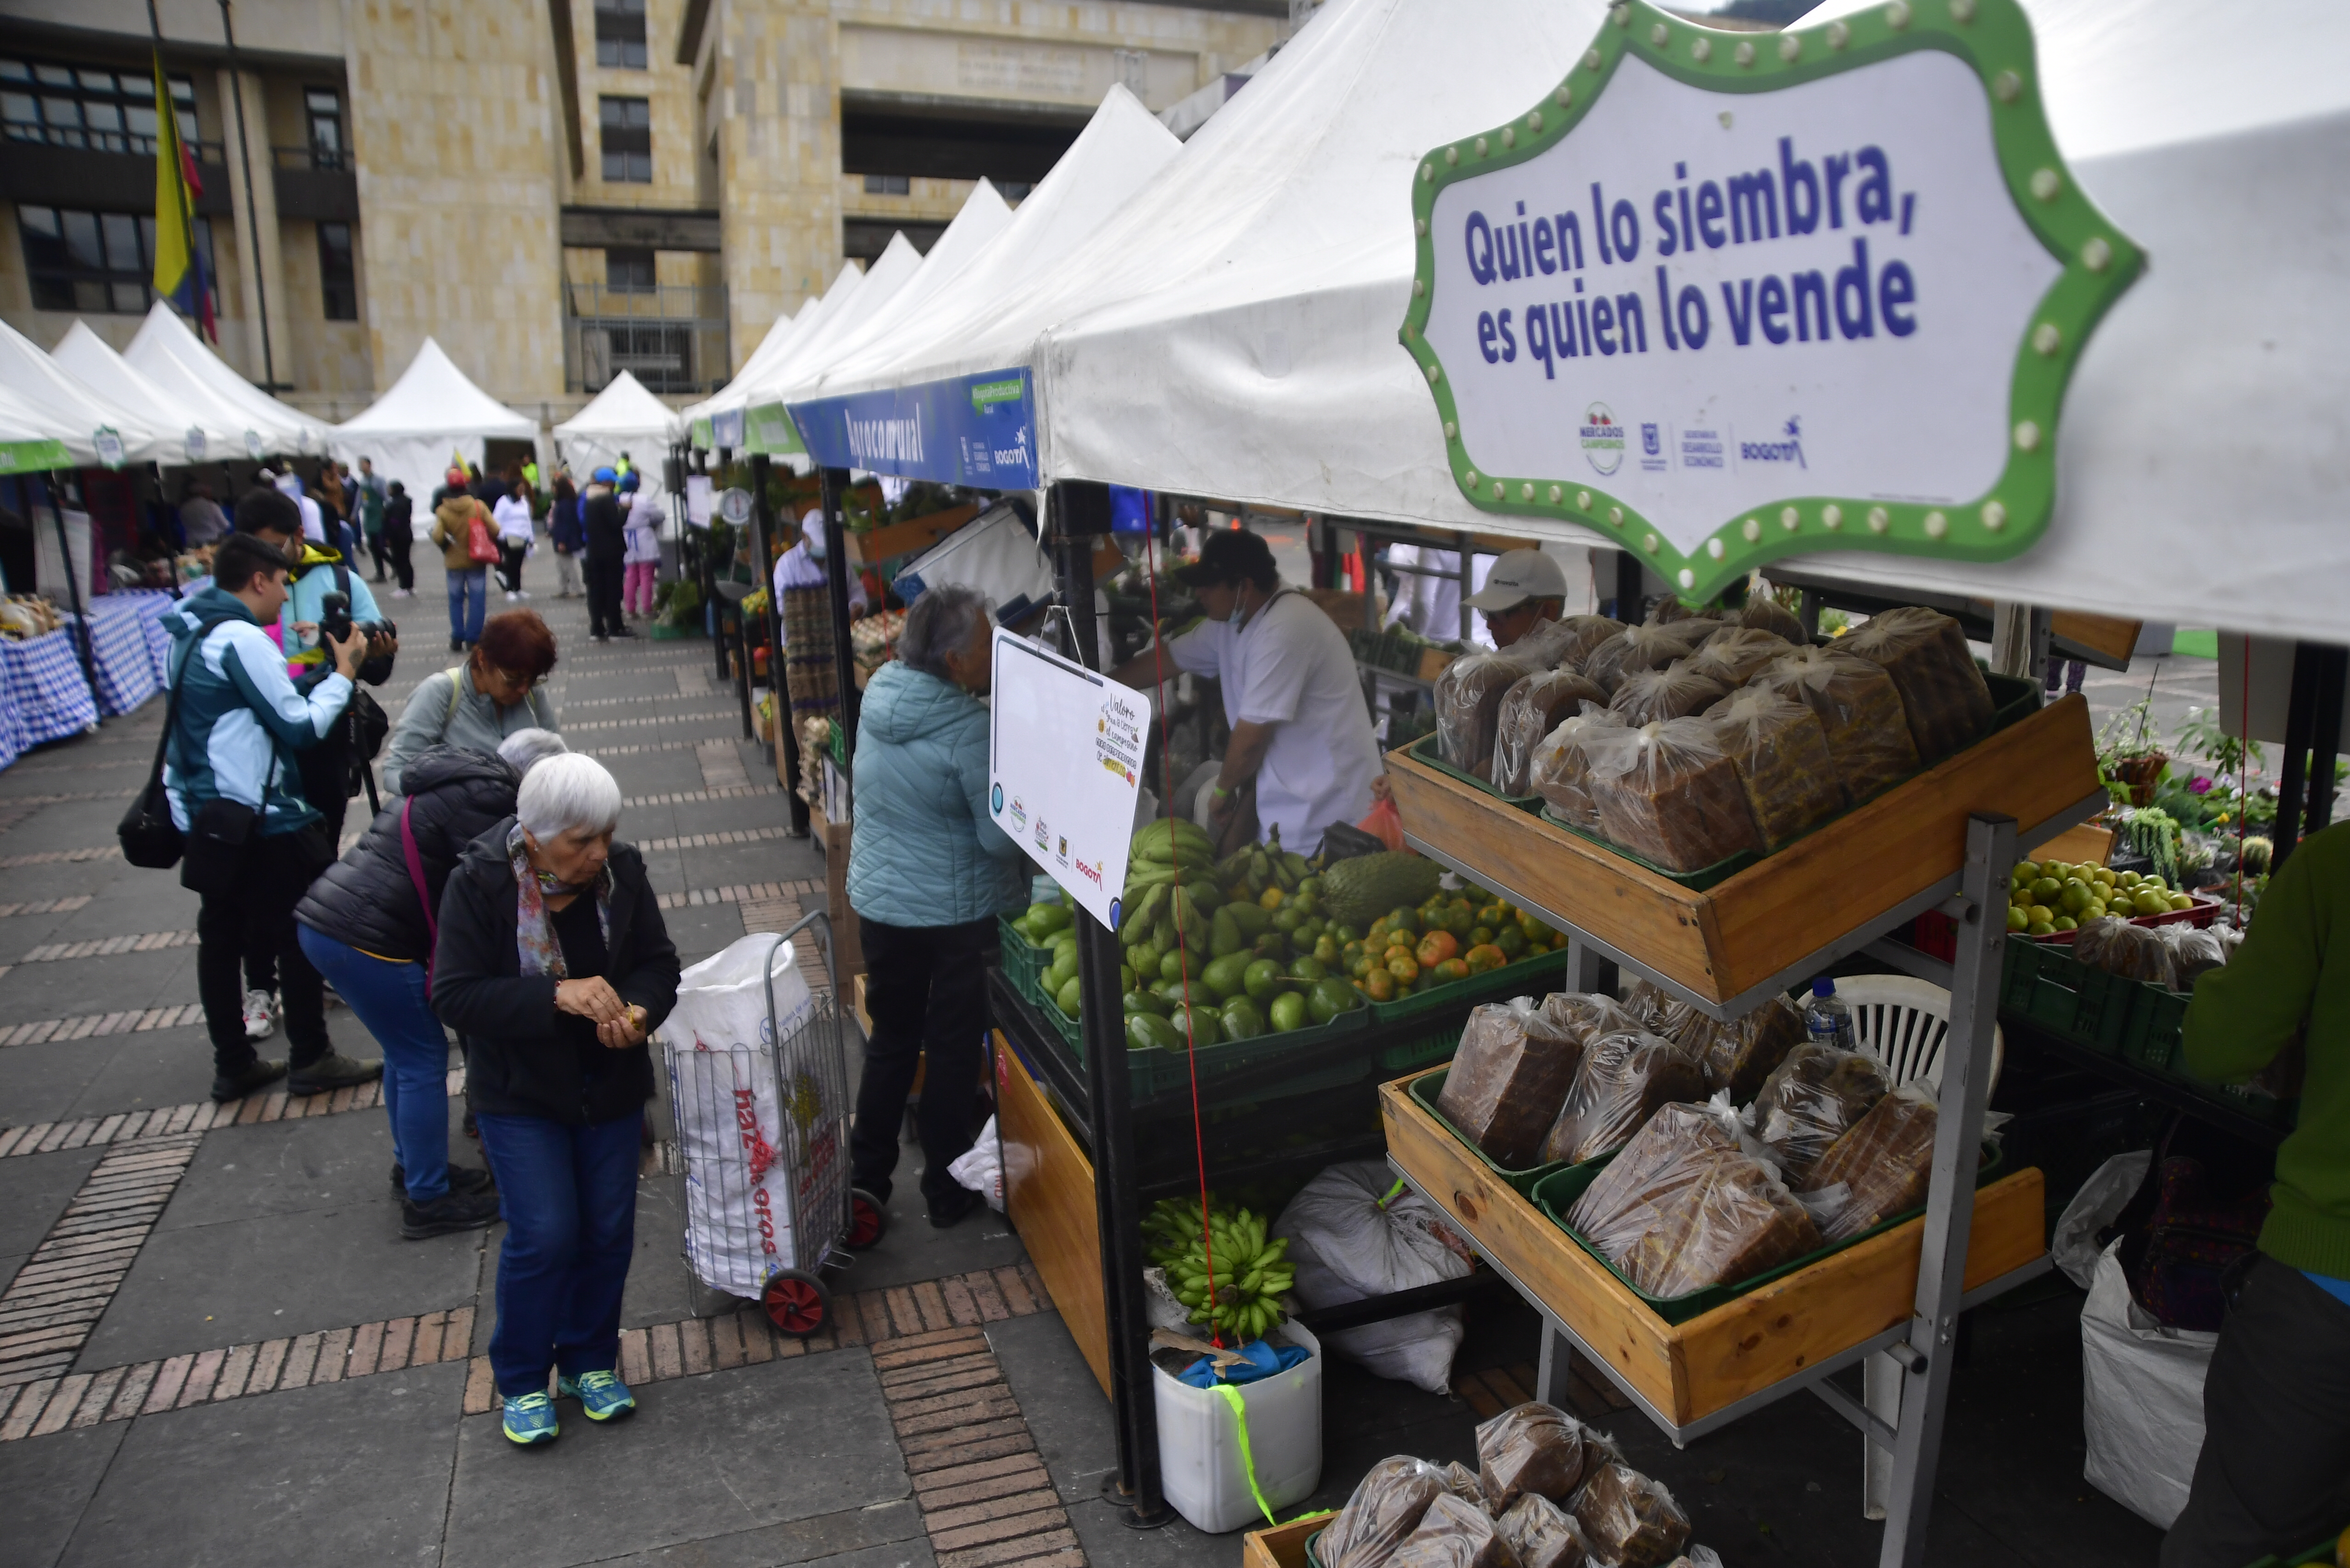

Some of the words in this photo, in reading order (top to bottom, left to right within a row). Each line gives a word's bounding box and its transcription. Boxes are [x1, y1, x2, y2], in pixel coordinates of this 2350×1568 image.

[1465, 200, 1583, 286] Quien
[1591, 181, 1640, 265] lo
[1653, 135, 1917, 257] siembra,
[1478, 306, 1516, 364] es
[1527, 278, 1648, 380] quien
[1656, 265, 1710, 351] lo
[1722, 235, 1918, 346] vende
[1580, 427, 1623, 437] MERCADOS
[1109, 693, 1135, 720] Valoro
[1096, 737, 1106, 750] CERO
[1106, 743, 1137, 769] DESPERDICIOS
[1106, 726, 1110, 737] el
[1111, 731, 1138, 752] campesino
[1097, 749, 1102, 762] de
[1103, 754, 1126, 777] alimentos
[753, 1187, 777, 1255] oros
